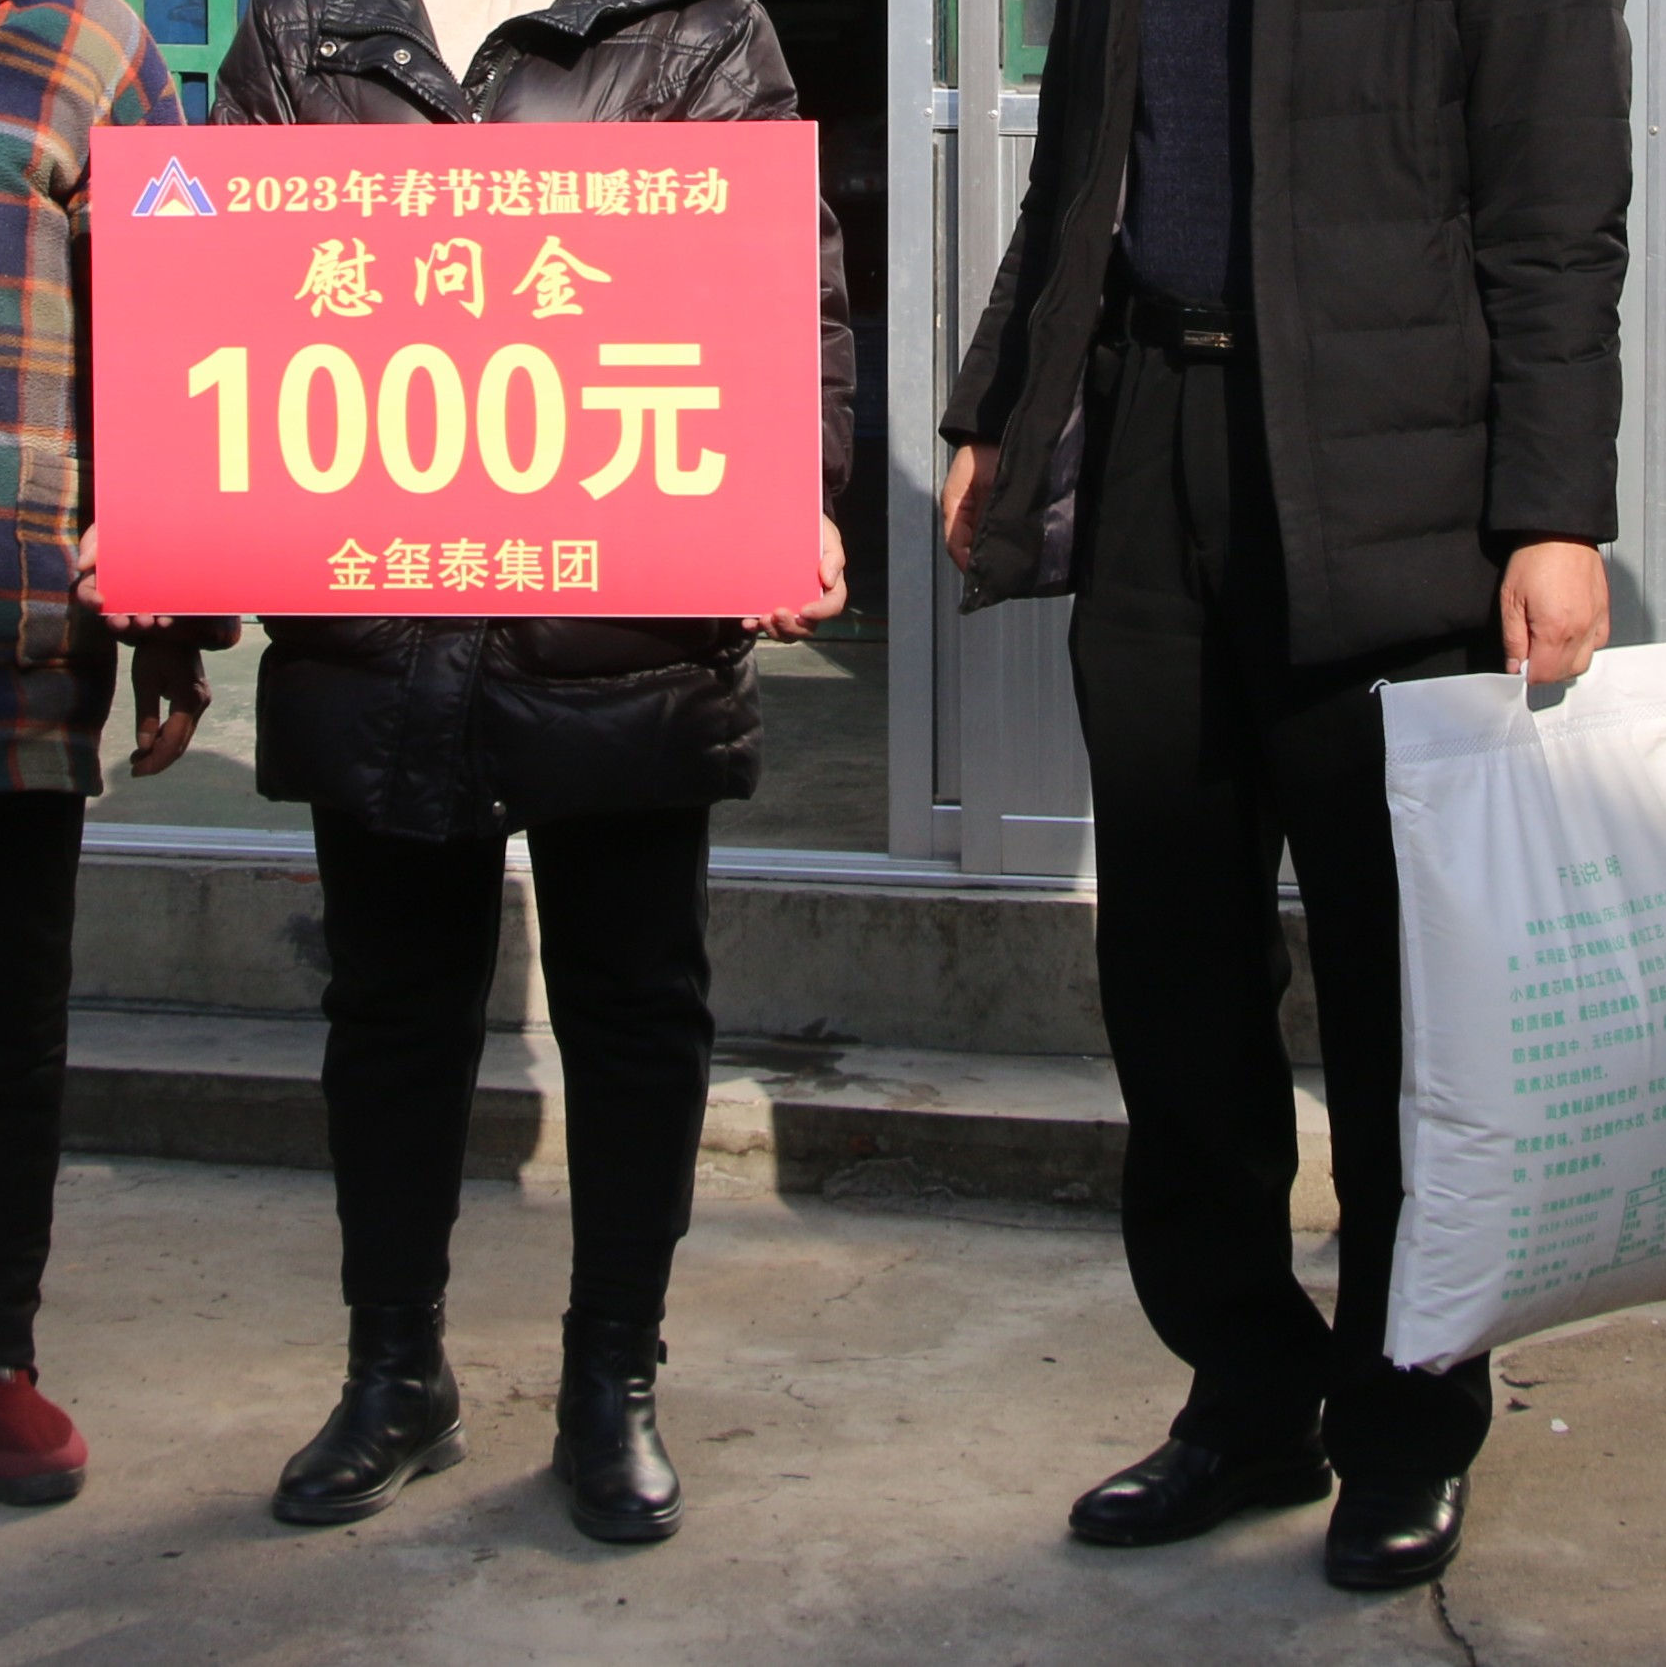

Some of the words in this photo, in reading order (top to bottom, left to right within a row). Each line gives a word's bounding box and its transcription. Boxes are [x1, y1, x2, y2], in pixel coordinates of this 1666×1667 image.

[227, 168, 729, 218] 2023年春节送温暖活动
[293, 235, 612, 319] 慰问金
[188, 343, 727, 501] 1000元
[327, 538, 600, 593] 金玺泰集团
